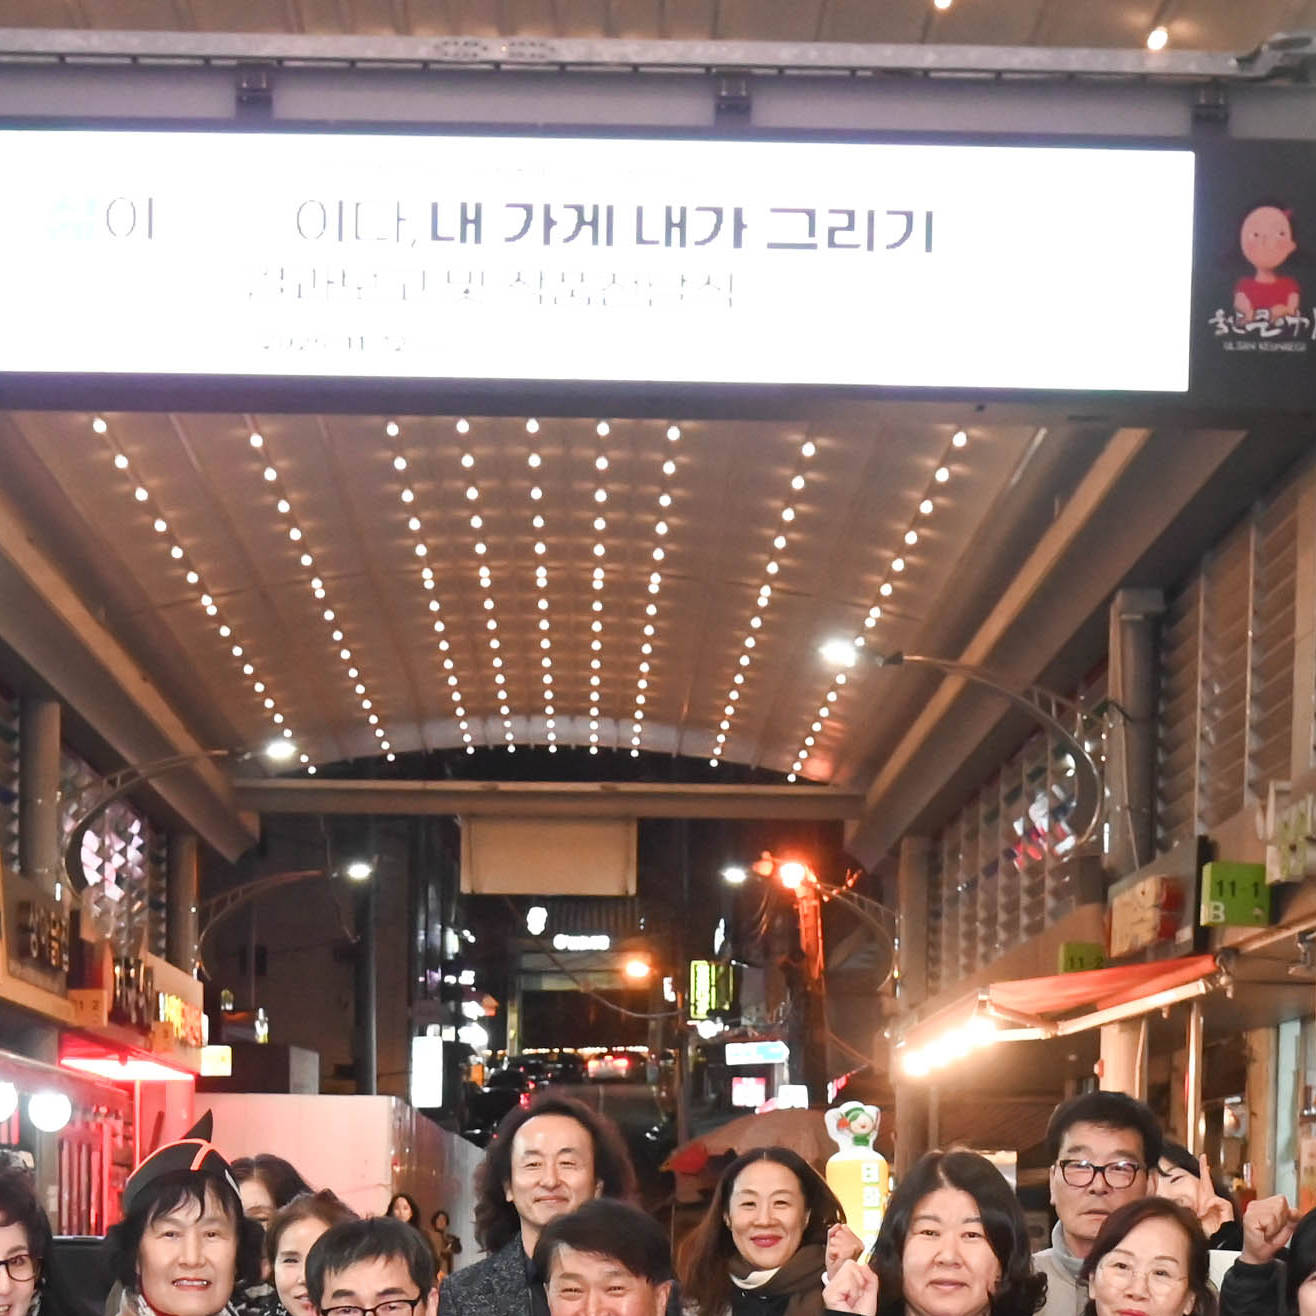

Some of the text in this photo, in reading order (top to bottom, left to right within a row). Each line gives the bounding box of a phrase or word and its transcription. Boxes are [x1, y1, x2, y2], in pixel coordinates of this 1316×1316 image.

[504, 202, 615, 247] 가게
[635, 204, 749, 250] 내가
[766, 207, 934, 253] 그리기
